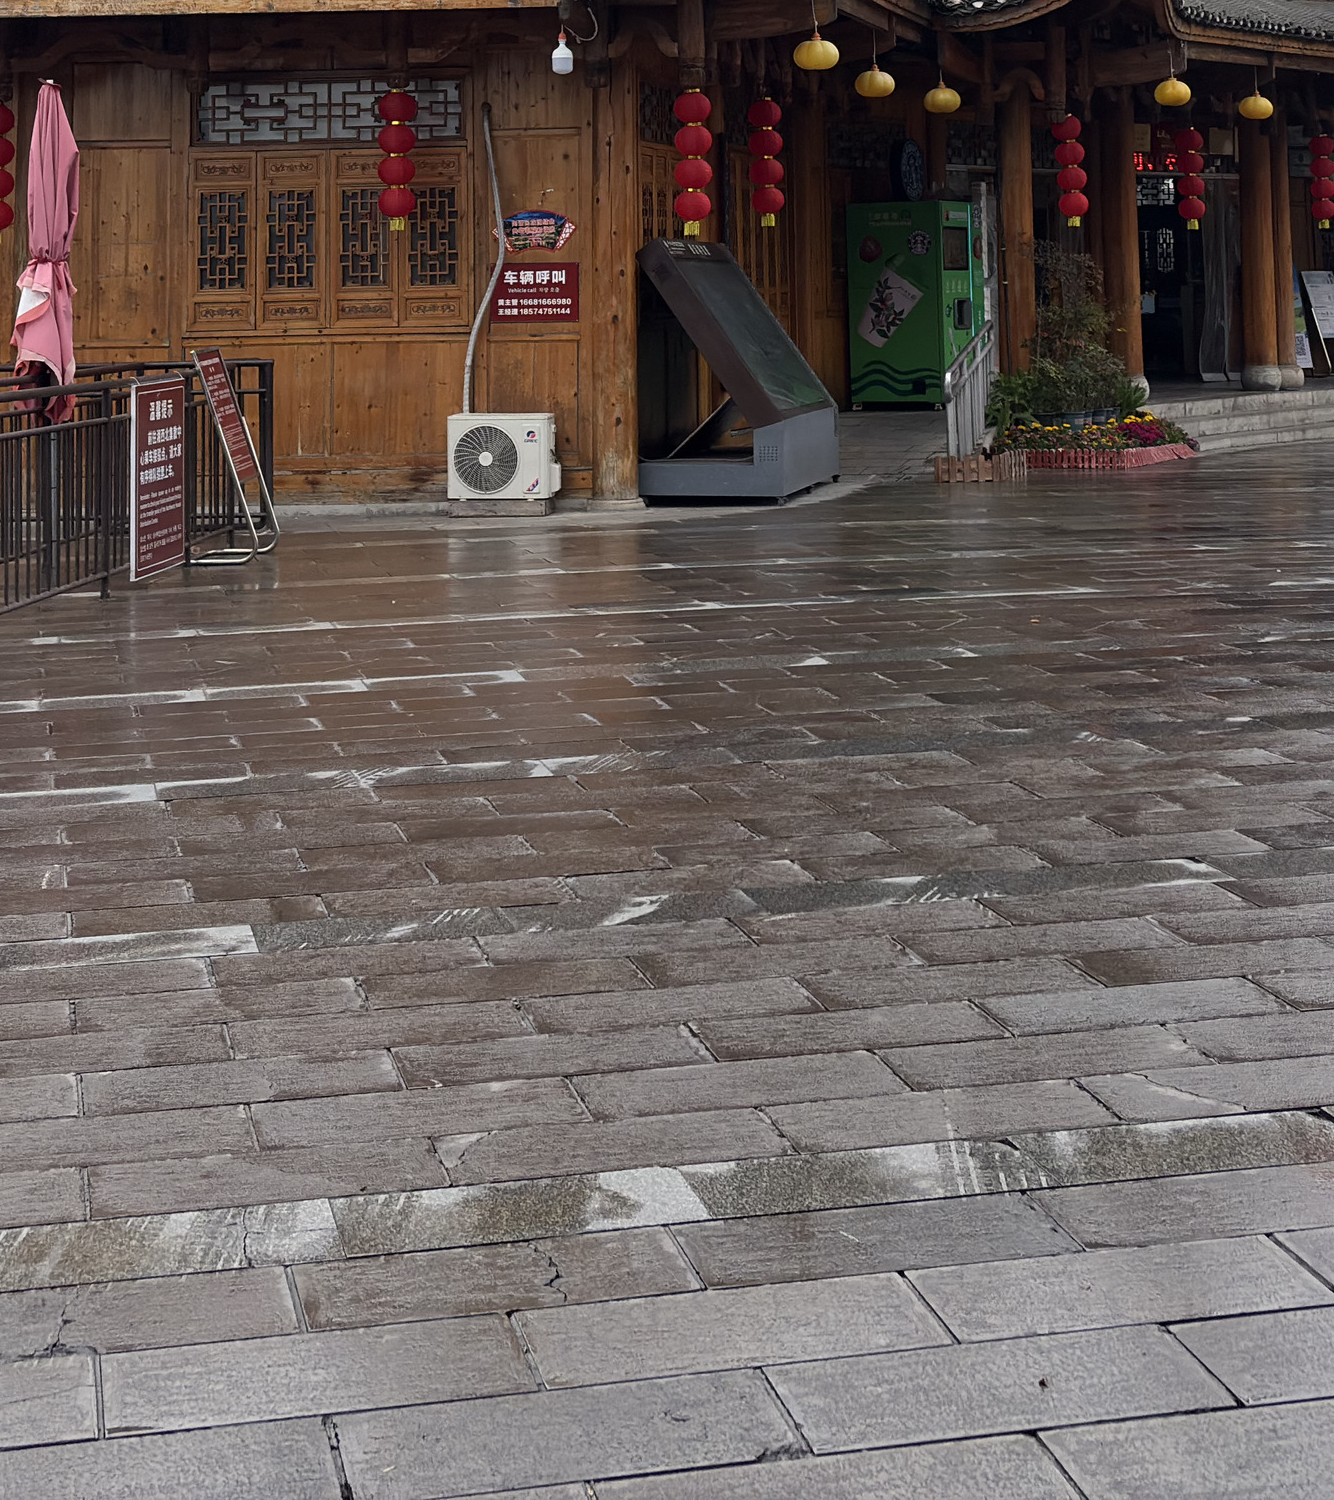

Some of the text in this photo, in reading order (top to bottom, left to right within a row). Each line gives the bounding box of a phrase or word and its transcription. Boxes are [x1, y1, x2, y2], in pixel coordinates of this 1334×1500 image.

[503, 269, 566, 285] 车辆呼叫
[149, 399, 173, 421] 温馨提示
